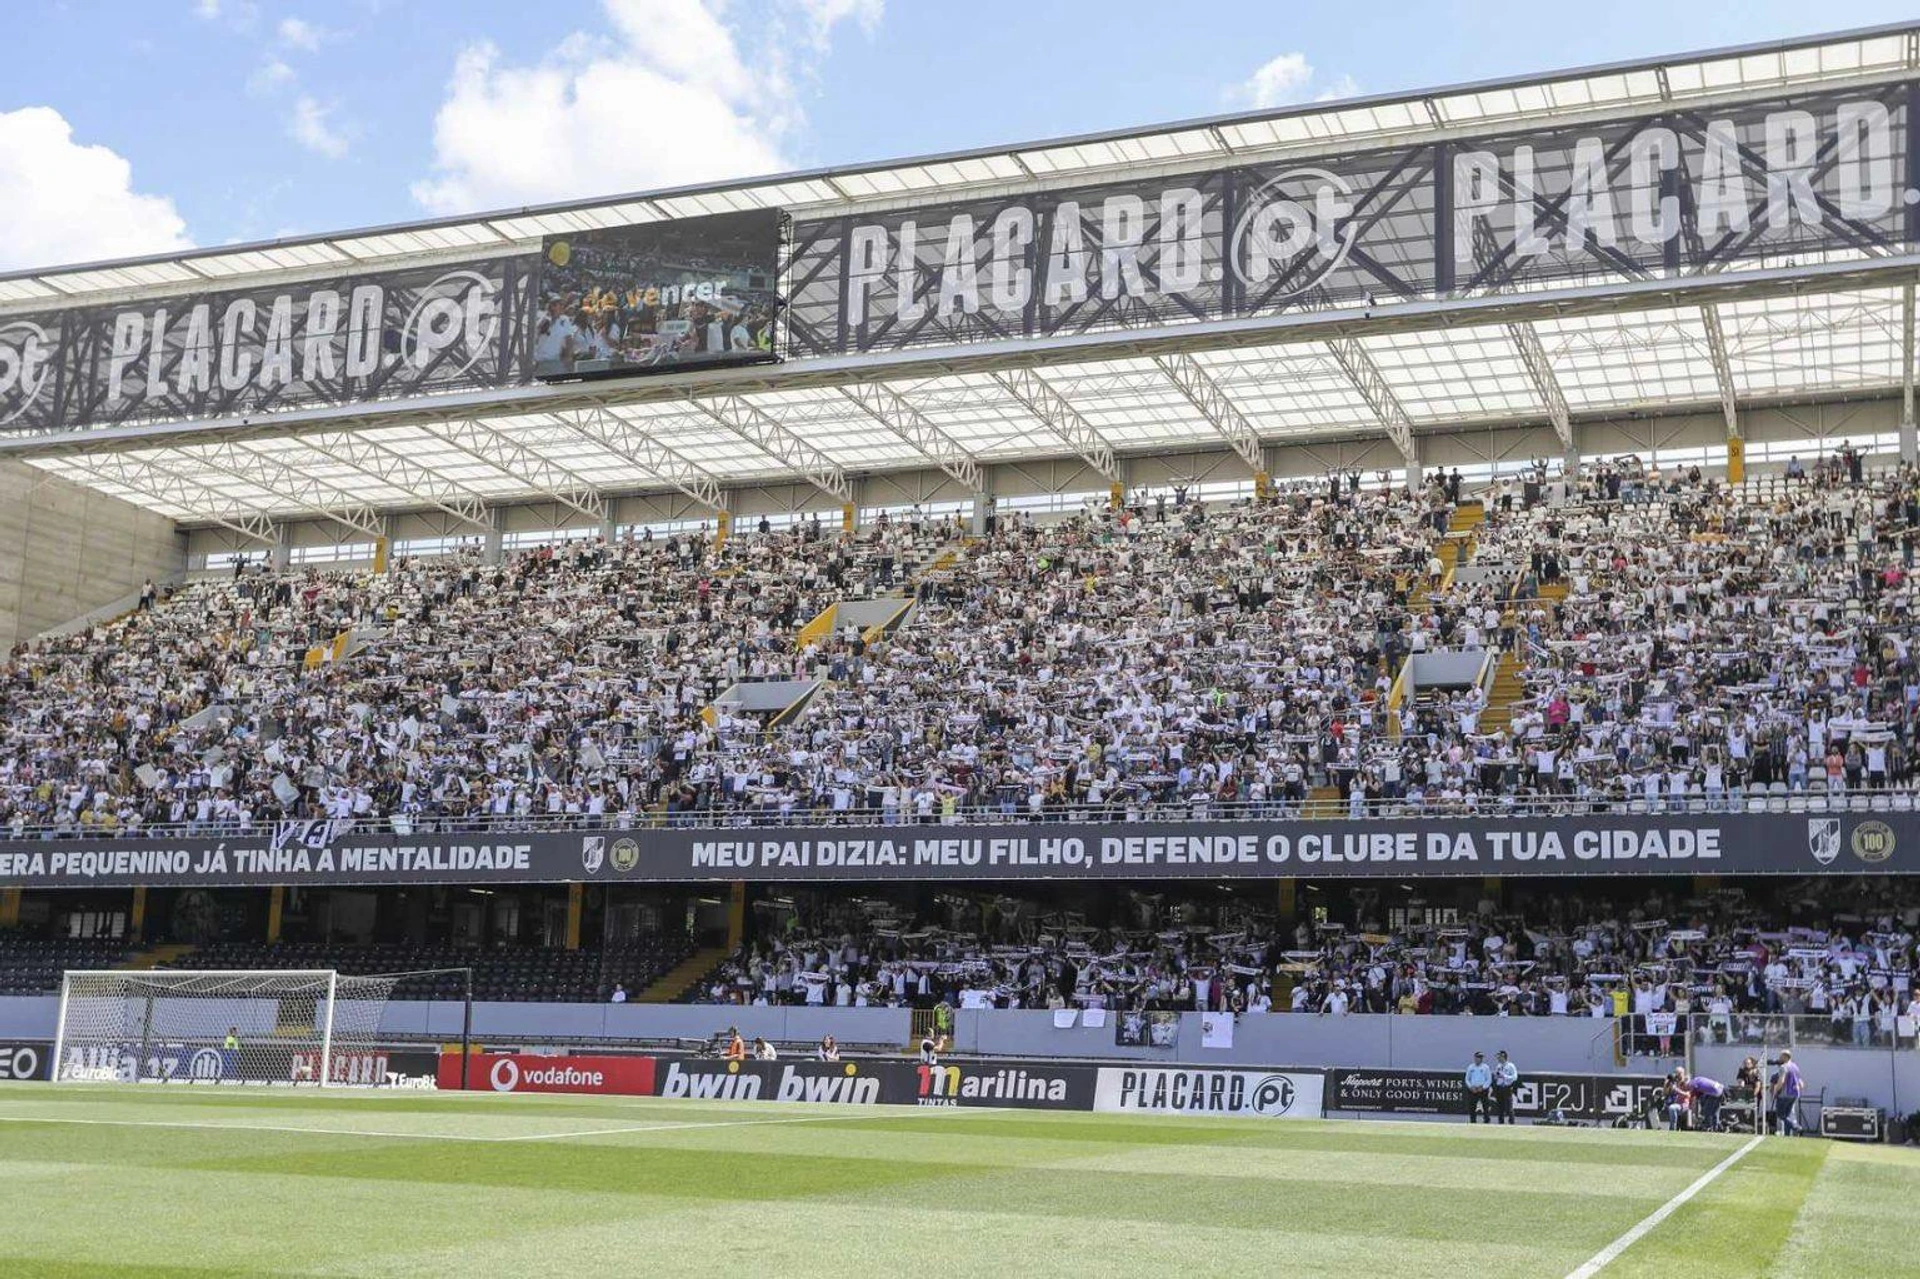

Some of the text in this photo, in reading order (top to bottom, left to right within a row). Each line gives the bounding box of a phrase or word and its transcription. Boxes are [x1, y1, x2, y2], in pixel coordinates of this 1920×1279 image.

[0, 844, 531, 877] ERA PEQUENINO JÁ TINHA A MENTALIDADE
[692, 828, 1722, 869] MEU PAI DIZIA: MEU FILHO, DEFENDE O CLUBE DA TUA CIDADE
[523, 1065, 603, 1086] vodafone
[662, 1061, 762, 1099] bwin
[776, 1062, 880, 1104] bwin
[1427, 1080, 1463, 1089] WINES
[1340, 1089, 1464, 1101] & ONLY GOOD TIMES!
